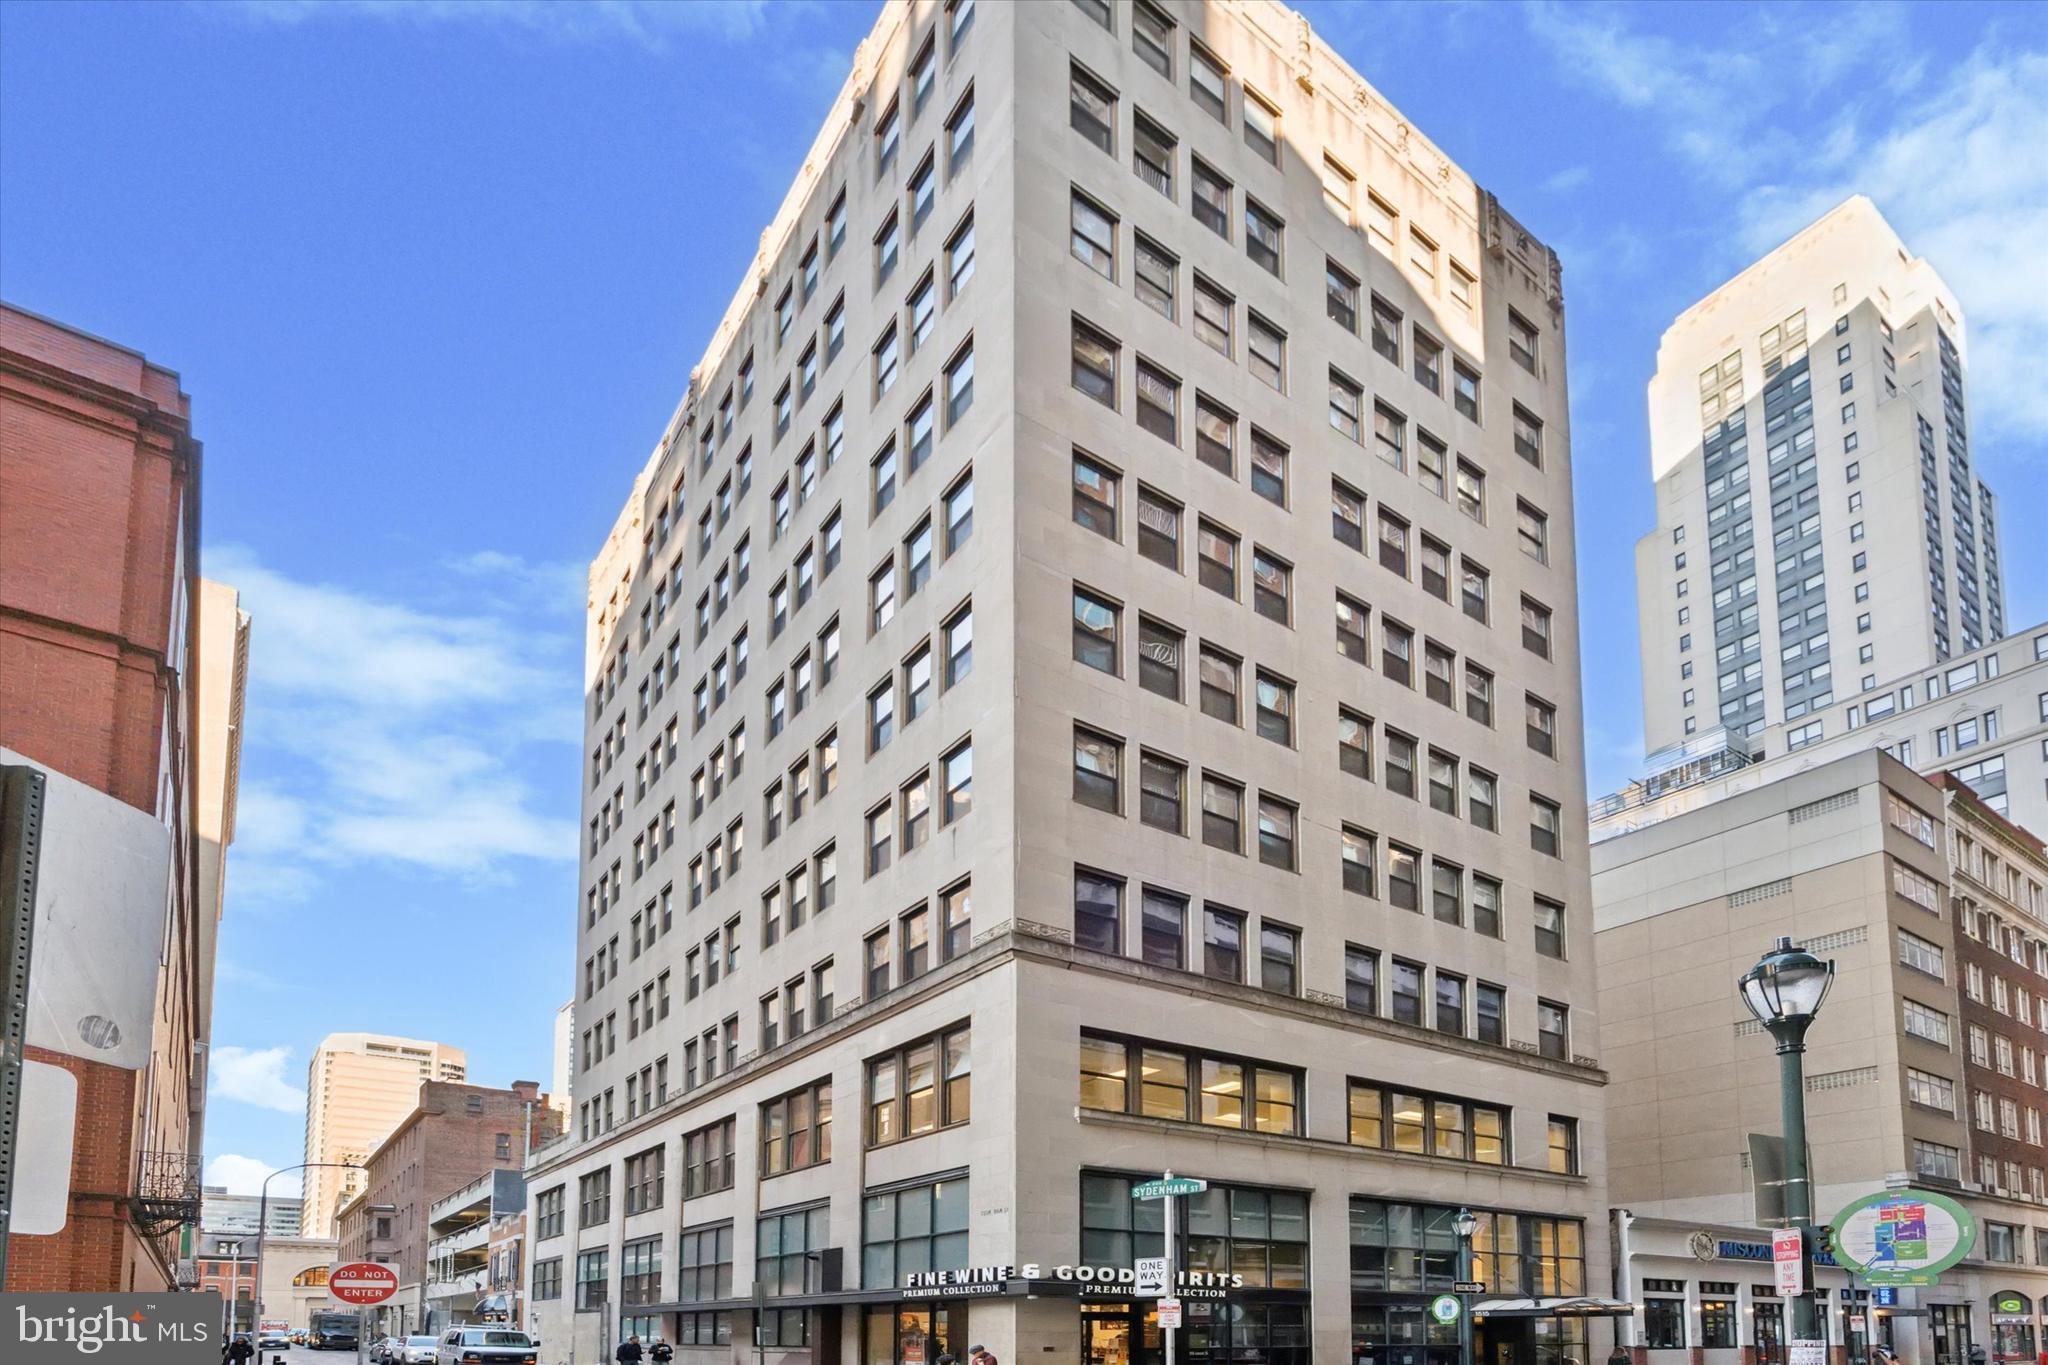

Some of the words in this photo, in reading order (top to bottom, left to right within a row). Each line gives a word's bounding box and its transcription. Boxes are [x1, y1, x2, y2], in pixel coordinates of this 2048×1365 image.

[1134, 1184, 1187, 1197] SYDENHAM
[1776, 1249, 1799, 1260] STOPPING
[1140, 1261, 1163, 1271] ONE
[1782, 1263, 1794, 1272] ANY
[340, 1270, 357, 1279] DO
[364, 1270, 389, 1279] NOT
[907, 1271, 947, 1287] FINE
[955, 1266, 1007, 1283] WINE
[1022, 1263, 1041, 1280] &
[1056, 1265, 1135, 1283] GOOD
[1172, 1271, 1244, 1288] IRITS
[1140, 1271, 1164, 1280] WAY
[1782, 1273, 1796, 1281] TIME
[343, 1289, 383, 1297] ENTER
[903, 1288, 941, 1297] PREMIUM
[943, 1284, 999, 1295] COLLECTION
[1086, 1285, 1136, 1295] PREMIU
[1172, 1288, 1227, 1298] LECTION
